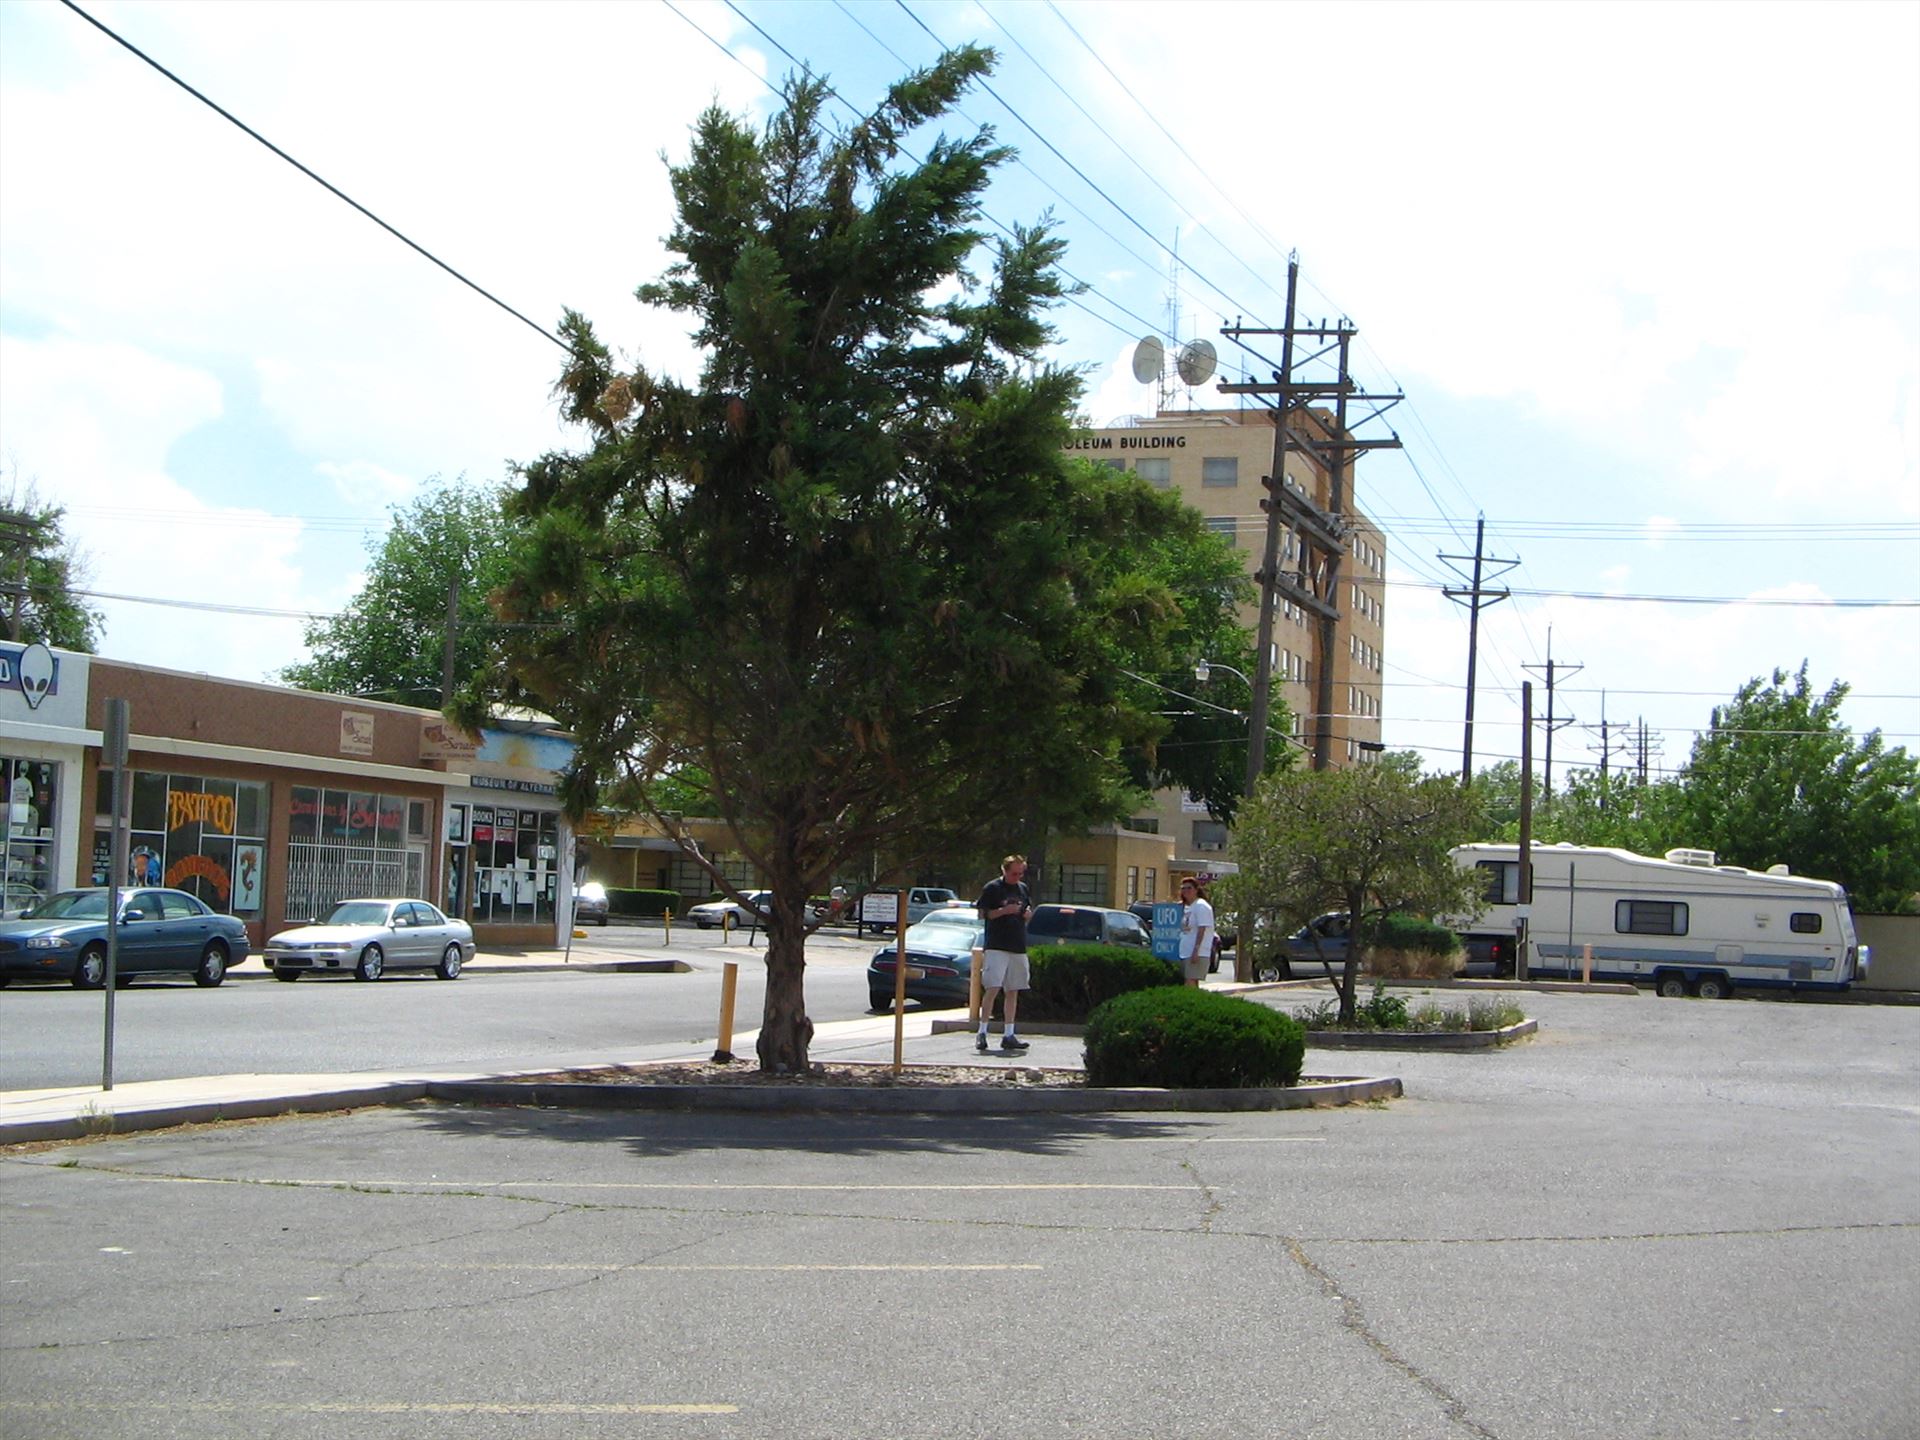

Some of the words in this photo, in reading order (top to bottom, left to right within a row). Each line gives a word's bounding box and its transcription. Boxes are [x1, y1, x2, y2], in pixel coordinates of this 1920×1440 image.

[1120, 436, 1186, 449] BUILDING
[472, 776, 506, 789] MUSEUM
[507, 780, 517, 789] OF
[520, 782, 556, 795] ALTERNA
[169, 790, 234, 835] TATTOO
[473, 810, 494, 823] BOOKS
[522, 813, 534, 825] ART
[1157, 908, 1178, 925] UFO
[1155, 943, 1176, 953] ONLY
